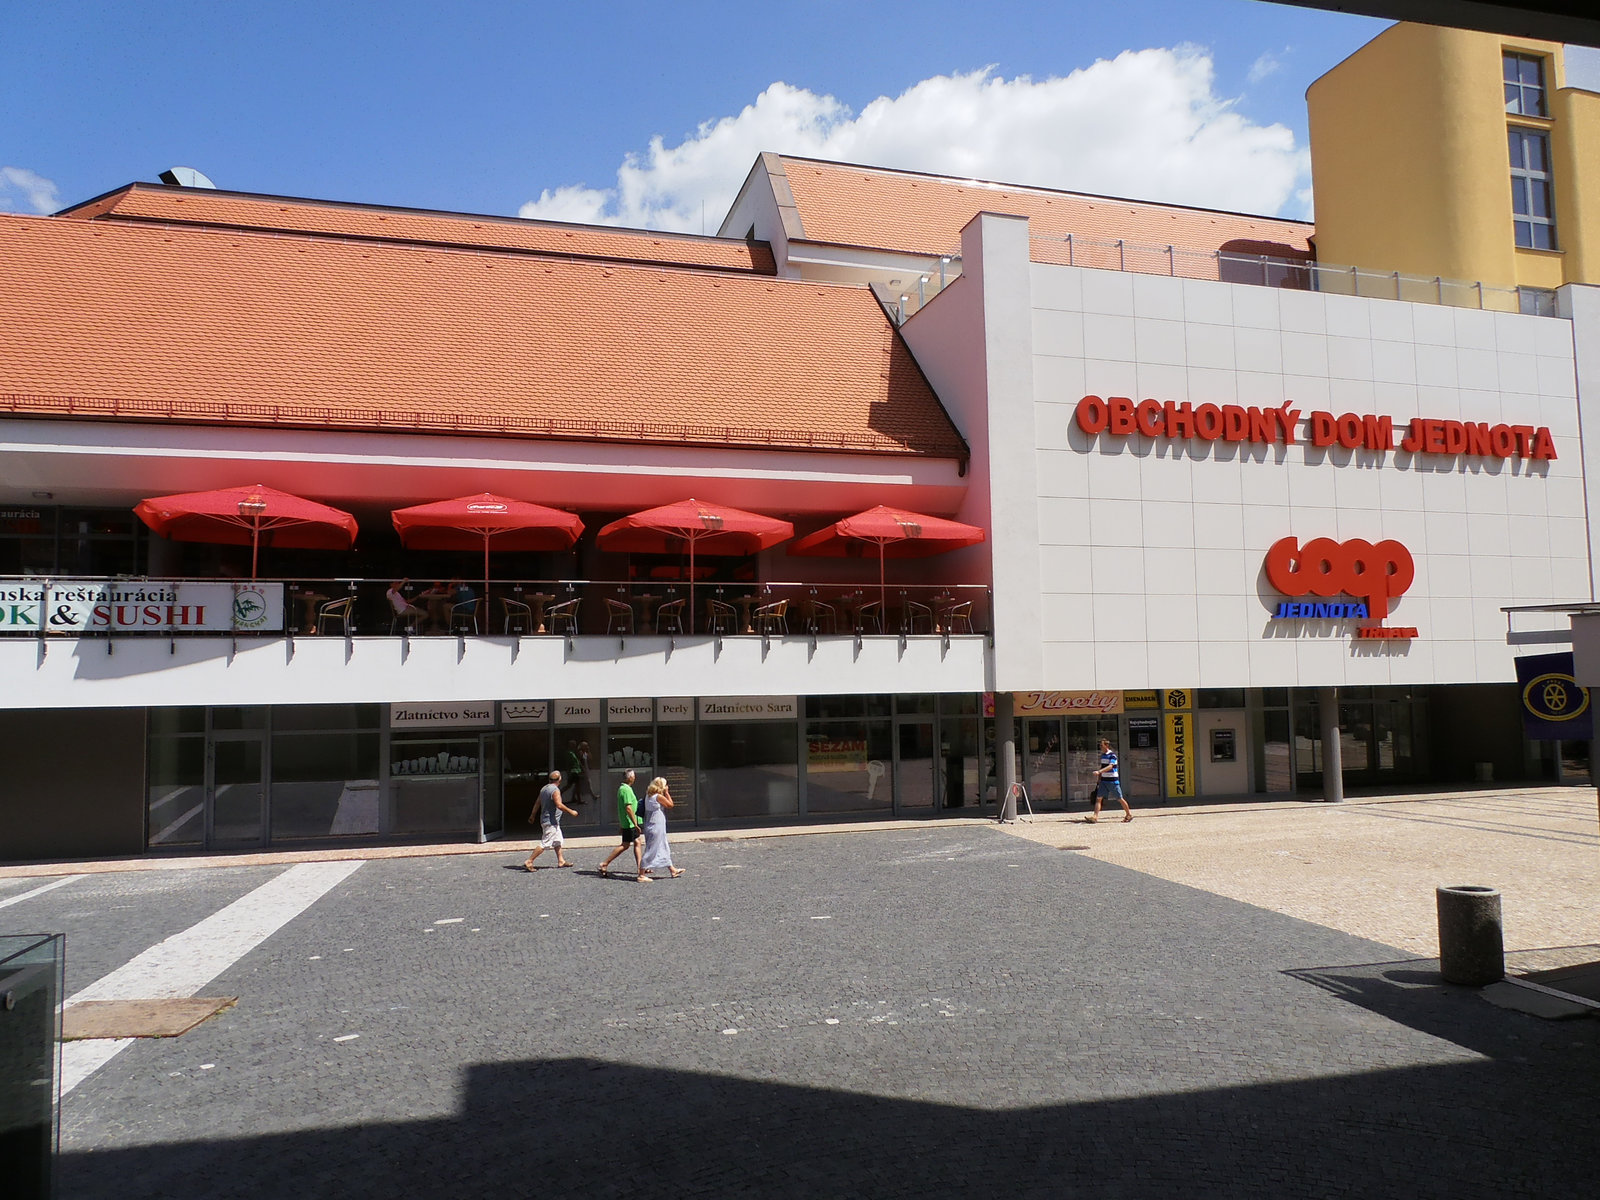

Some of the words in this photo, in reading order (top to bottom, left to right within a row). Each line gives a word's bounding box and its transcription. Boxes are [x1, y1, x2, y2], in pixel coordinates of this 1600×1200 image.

[1076, 395, 1301, 445] OBCHODNÝ
[1311, 410, 1394, 450] DOM
[1401, 417, 1558, 460] JEDNOTA
[54, 586, 178, 602] reštaurácia
[0, 604, 37, 625] K
[49, 604, 79, 625] &
[93, 605, 207, 625] SUSHI
[1271, 603, 1369, 619] JEDNOTA
[704, 702, 763, 714] Zlatníctvo
[767, 702, 793, 713] Sara
[1021, 691, 1118, 713] Kvety
[395, 709, 458, 721] Zlatníctvo
[462, 708, 490, 719] Sara
[564, 706, 591, 715] Zlato
[609, 705, 651, 714] Striebro
[663, 704, 689, 715] Perly
[808, 740, 865, 753] SEZAM
[1172, 715, 1186, 795] ZMENÁREŇ
